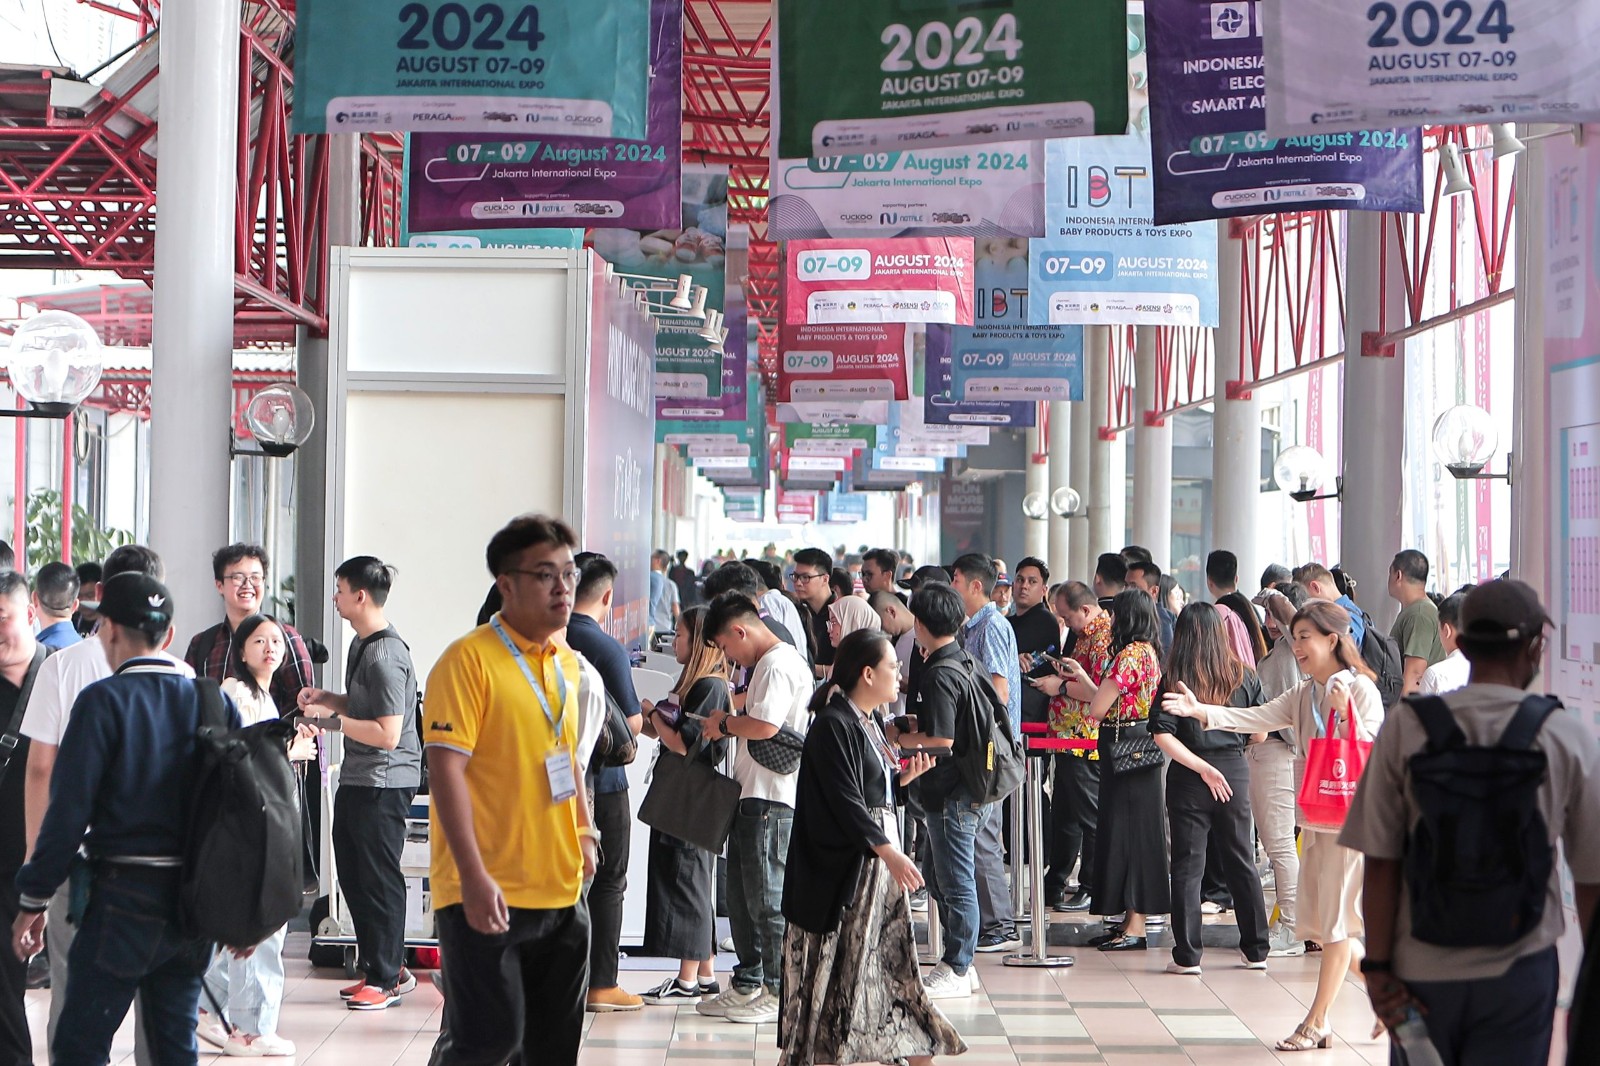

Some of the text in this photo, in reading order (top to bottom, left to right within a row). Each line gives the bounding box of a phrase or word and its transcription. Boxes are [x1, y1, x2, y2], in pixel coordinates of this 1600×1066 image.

[397, 3, 546, 51] 2024
[1367, 0, 1514, 48] 2024
[880, 13, 1024, 72] 2024
[396, 57, 546, 75] AUGUST 07-09
[1368, 51, 1516, 71] AUGUST 07-09
[396, 80, 545, 90] JAKARTA INTERNATIONAL EXPO
[880, 66, 1024, 96] AUGUST 07-09
[1369, 76, 1409, 86] JAKARTA
[1413, 74, 1490, 84] INTERNATIONAL
[881, 98, 922, 111] JAKARTA
[1192, 96, 1246, 114] SMART
[1200, 136, 1225, 154] 07
[1244, 132, 1268, 150] 09
[1284, 131, 1354, 156] August
[1358, 130, 1409, 150] 2024
[456, 144, 482, 162] 07
[502, 143, 526, 160] 09
[540, 145, 609, 167] August
[614, 145, 666, 162] 2024
[1236, 152, 1362, 168] Jakarta International Expo
[818, 155, 843, 170] 07
[863, 153, 889, 170] 09
[904, 154, 971, 176] August
[976, 154, 1029, 171] 2024
[492, 168, 617, 180] Jakarta International Expo
[851, 177, 982, 188] Jakarta International Expo
[1068, 166, 1148, 209] IBT
[1066, 216, 1116, 225] INDONESIA
[1060, 228, 1193, 238] BABY PRODUCTS & TOYS EXPO
[803, 255, 965, 274] 07-09 AUGUST 2024
[902, 268, 948, 276] INTERNATIONAL
[1046, 256, 1208, 275] 07-09 AUGUST 2024
[788, 353, 899, 368] 07-09 AUGUST 2024
[962, 353, 1004, 366] 07-09
[1012, 352, 1052, 361] AUGUST
[1053, 353, 1076, 362] 2024
